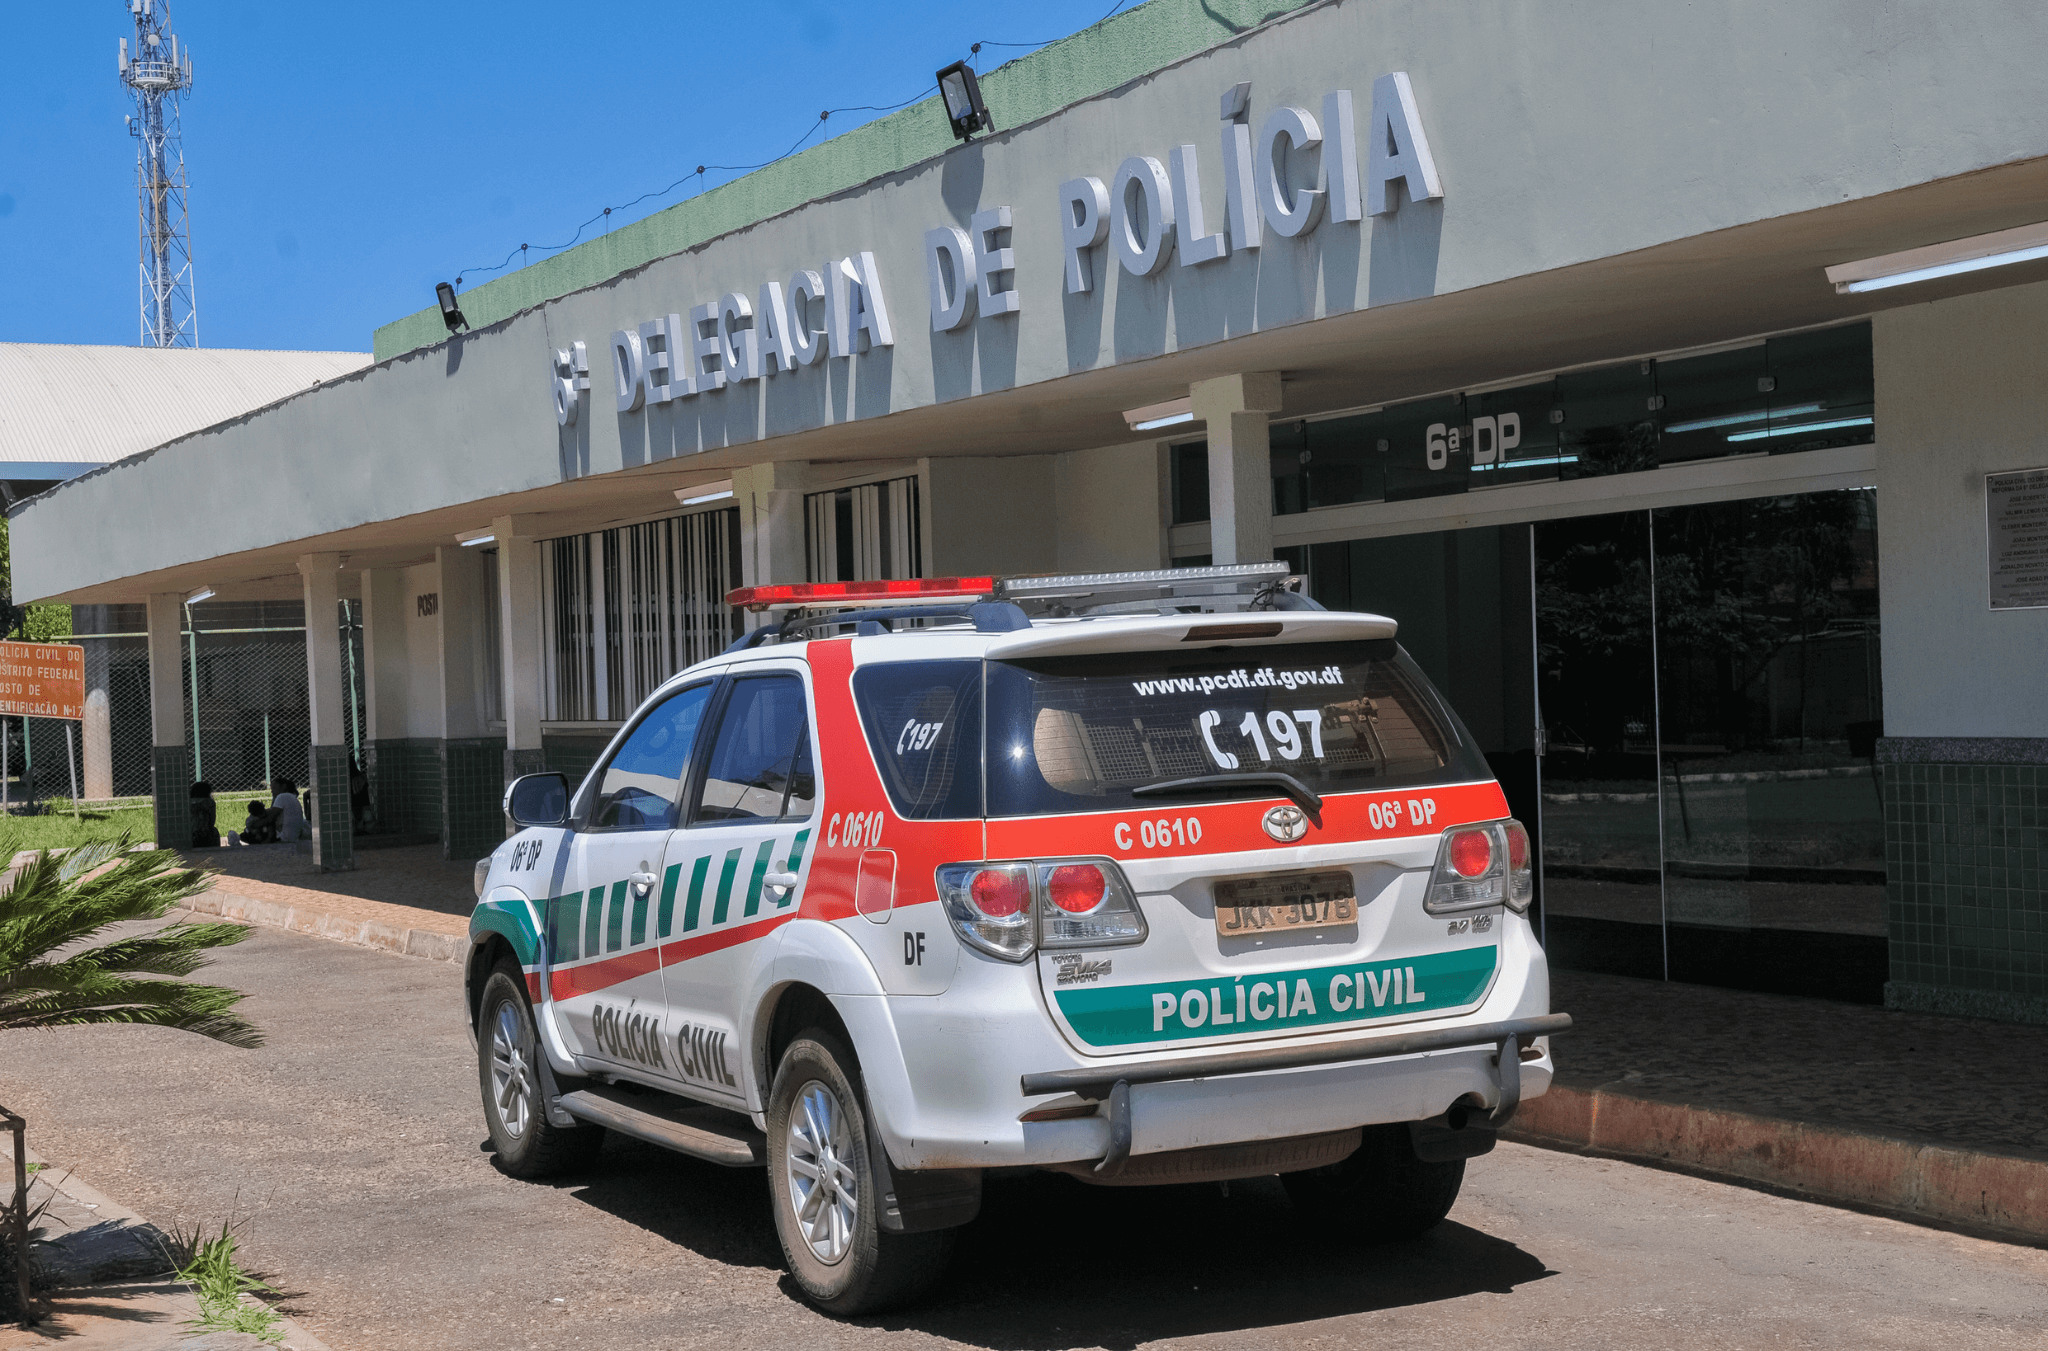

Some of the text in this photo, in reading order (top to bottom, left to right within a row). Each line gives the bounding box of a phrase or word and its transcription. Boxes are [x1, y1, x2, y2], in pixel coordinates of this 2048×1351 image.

[611, 251, 894, 413] DELEGACIA
[925, 204, 1020, 333] DE
[1060, 71, 1445, 294] POLÍCIA
[1426, 412, 1521, 471] 6ª DP
[36, 647, 61, 661] CIVIL
[68, 650, 80, 662] DO
[29, 684, 41, 696] DE
[38, 666, 80, 681] FEDERAL
[1133, 666, 1344, 697] www.pcdf.df.gov.df
[907, 722, 944, 751] 197
[1239, 709, 1325, 762] 197
[827, 810, 884, 848] C 0610
[1368, 798, 1437, 831] 06ª DP
[1114, 816, 1202, 851] C 0610
[526, 839, 543, 872] DP
[904, 931, 926, 966] DF
[1060, 958, 1113, 976] SW4
[1153, 965, 1426, 1032] POLÍCIA CIVIL
[592, 998, 737, 1087] POLÍCIA CIVIL
